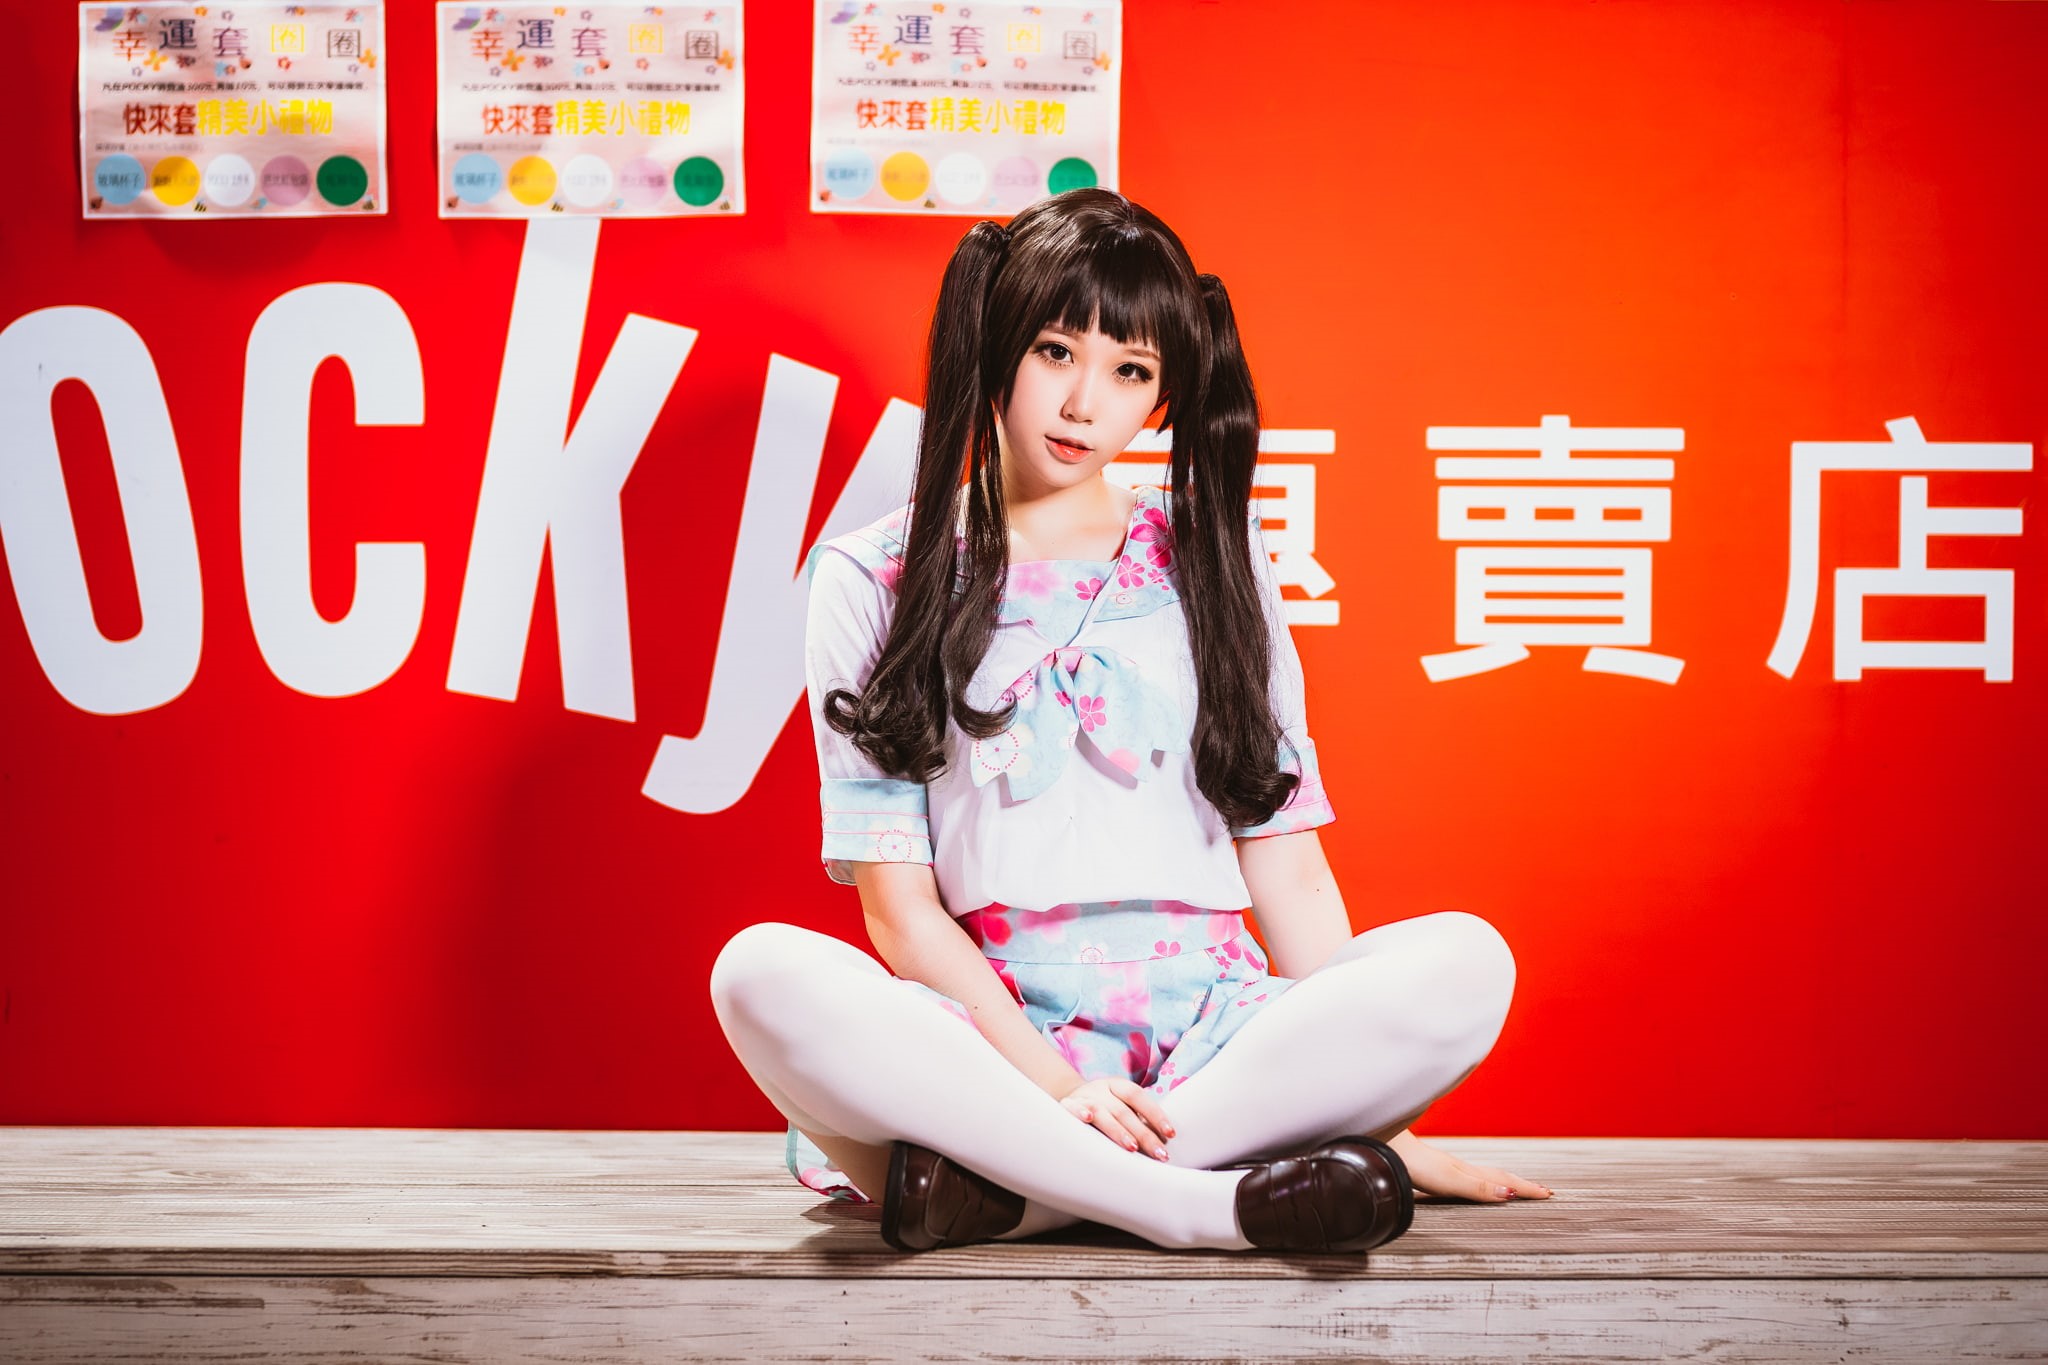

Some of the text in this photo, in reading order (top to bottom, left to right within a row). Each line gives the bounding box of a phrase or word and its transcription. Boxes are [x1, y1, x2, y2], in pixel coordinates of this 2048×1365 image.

[123, 99, 333, 136] 快來套精美小禮物
[481, 99, 691, 136] 快來套精美小禮物
[856, 97, 1066, 135] 快來套精美小禮物
